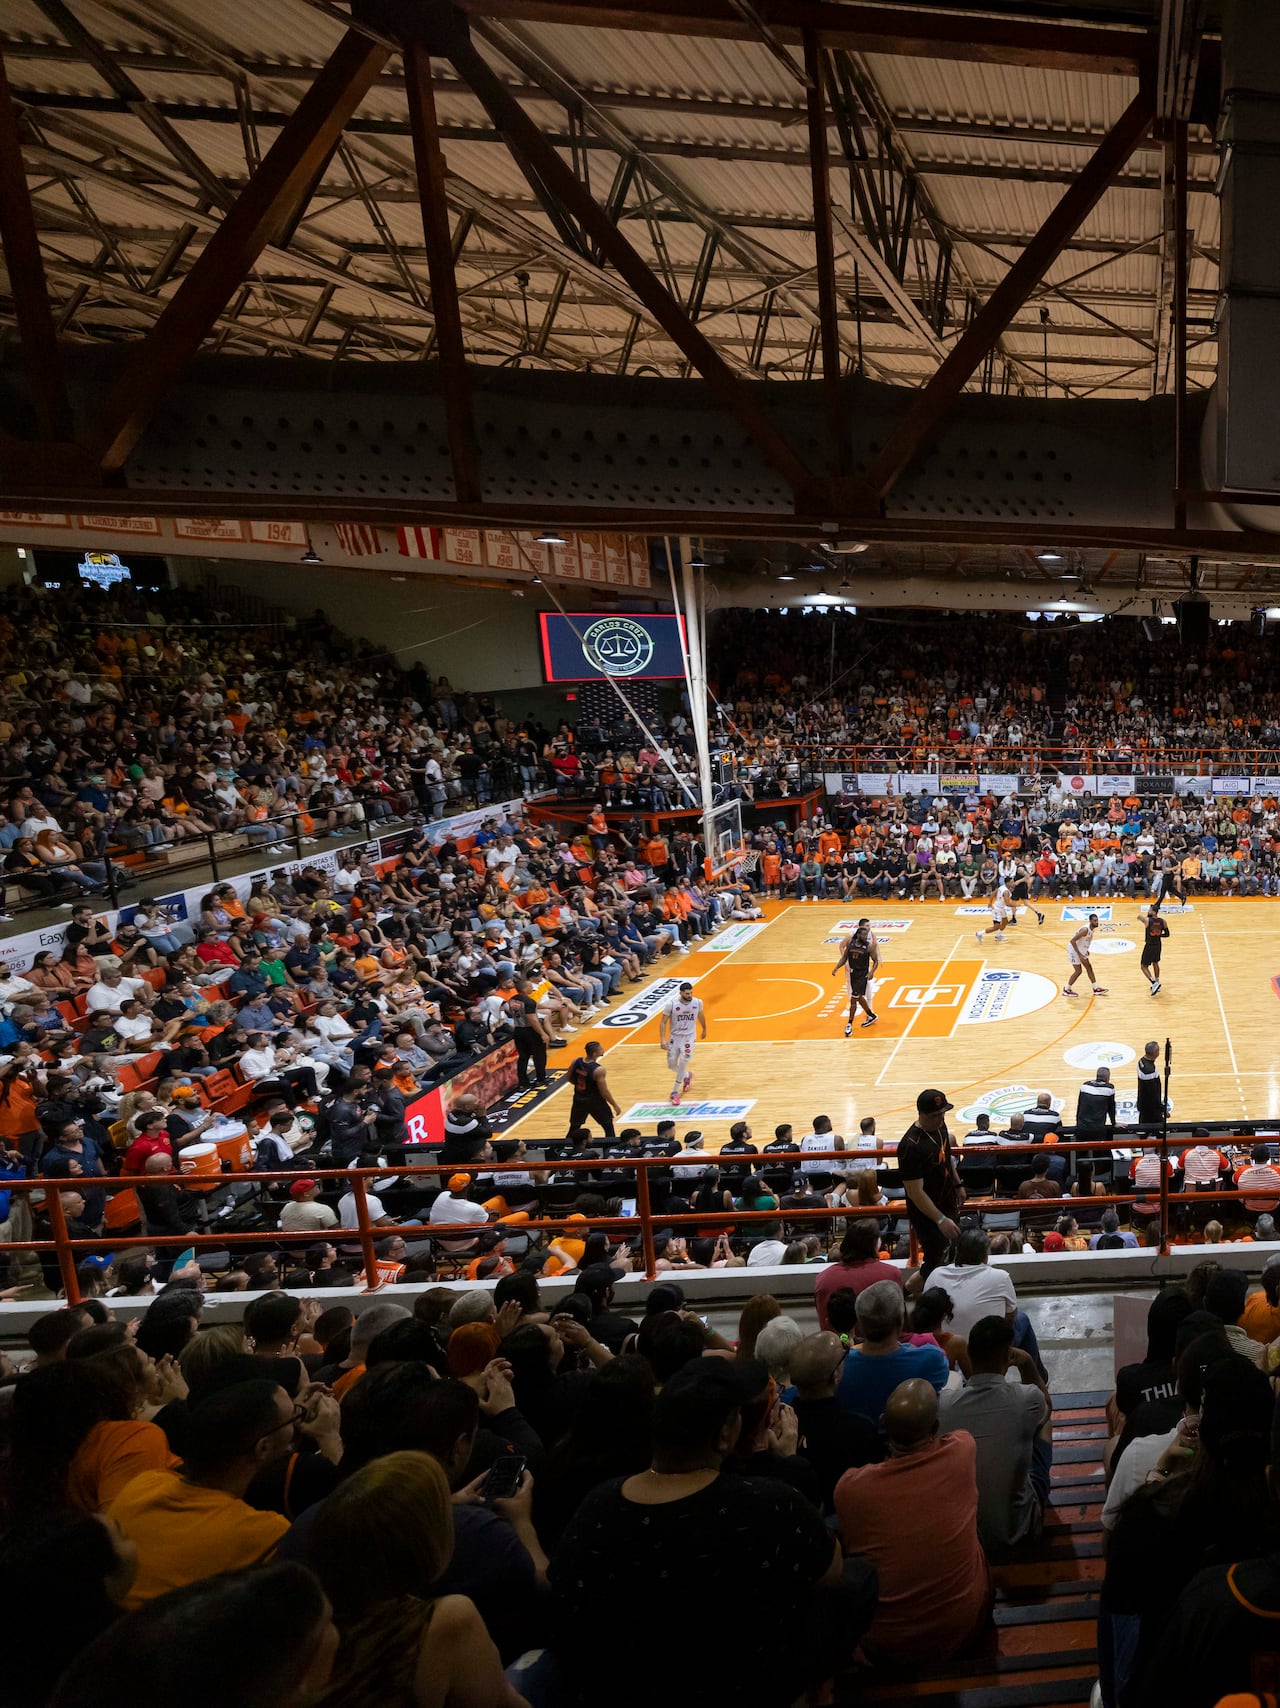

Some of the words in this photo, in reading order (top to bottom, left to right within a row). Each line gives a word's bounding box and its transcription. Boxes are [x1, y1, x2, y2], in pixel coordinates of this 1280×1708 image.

[267, 523, 293, 541] 1947
[455, 548, 473, 563] 1948
[590, 621, 621, 639] CARLOS
[623, 622, 644, 640] CRUZ
[40, 930, 66, 947] Easy
[629, 978, 683, 1011] TARGET
